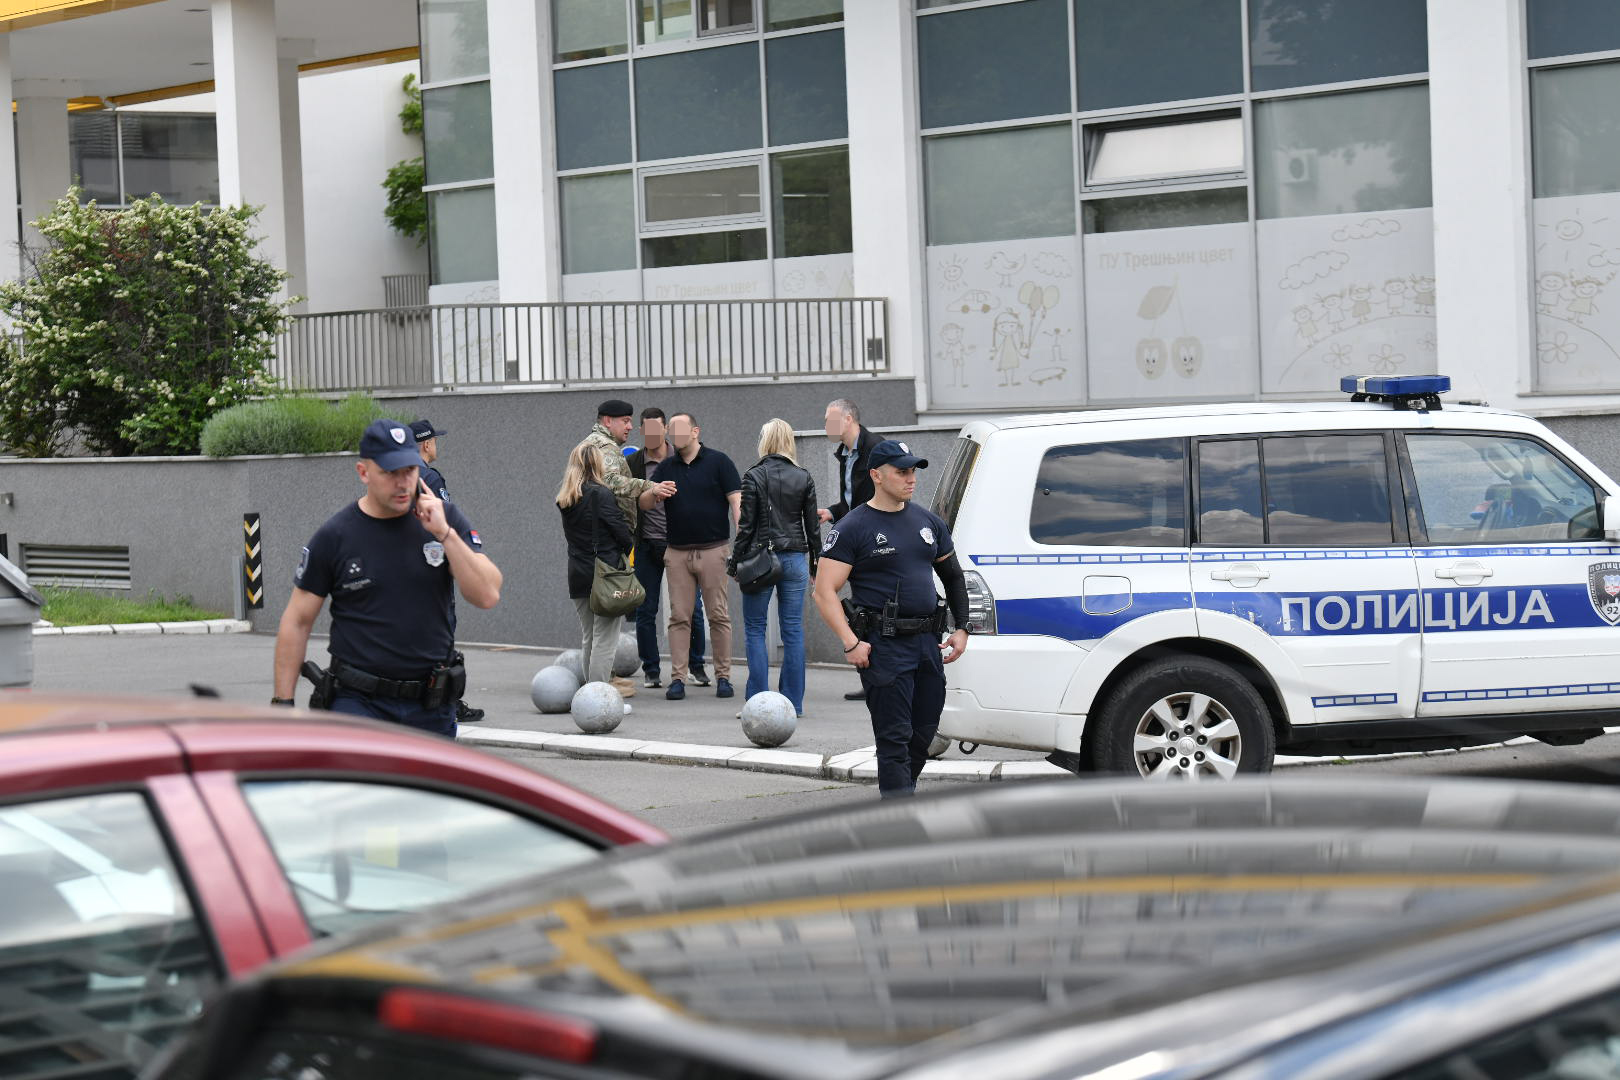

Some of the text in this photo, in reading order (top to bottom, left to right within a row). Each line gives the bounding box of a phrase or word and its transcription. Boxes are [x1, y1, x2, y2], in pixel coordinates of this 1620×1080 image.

[1099, 252, 1120, 270] ПУ
[1200, 247, 1234, 267] цвет
[1589, 562, 1620, 573] ПОЛИЦ
[1281, 590, 1555, 631] ПОЛИЦИЈА
